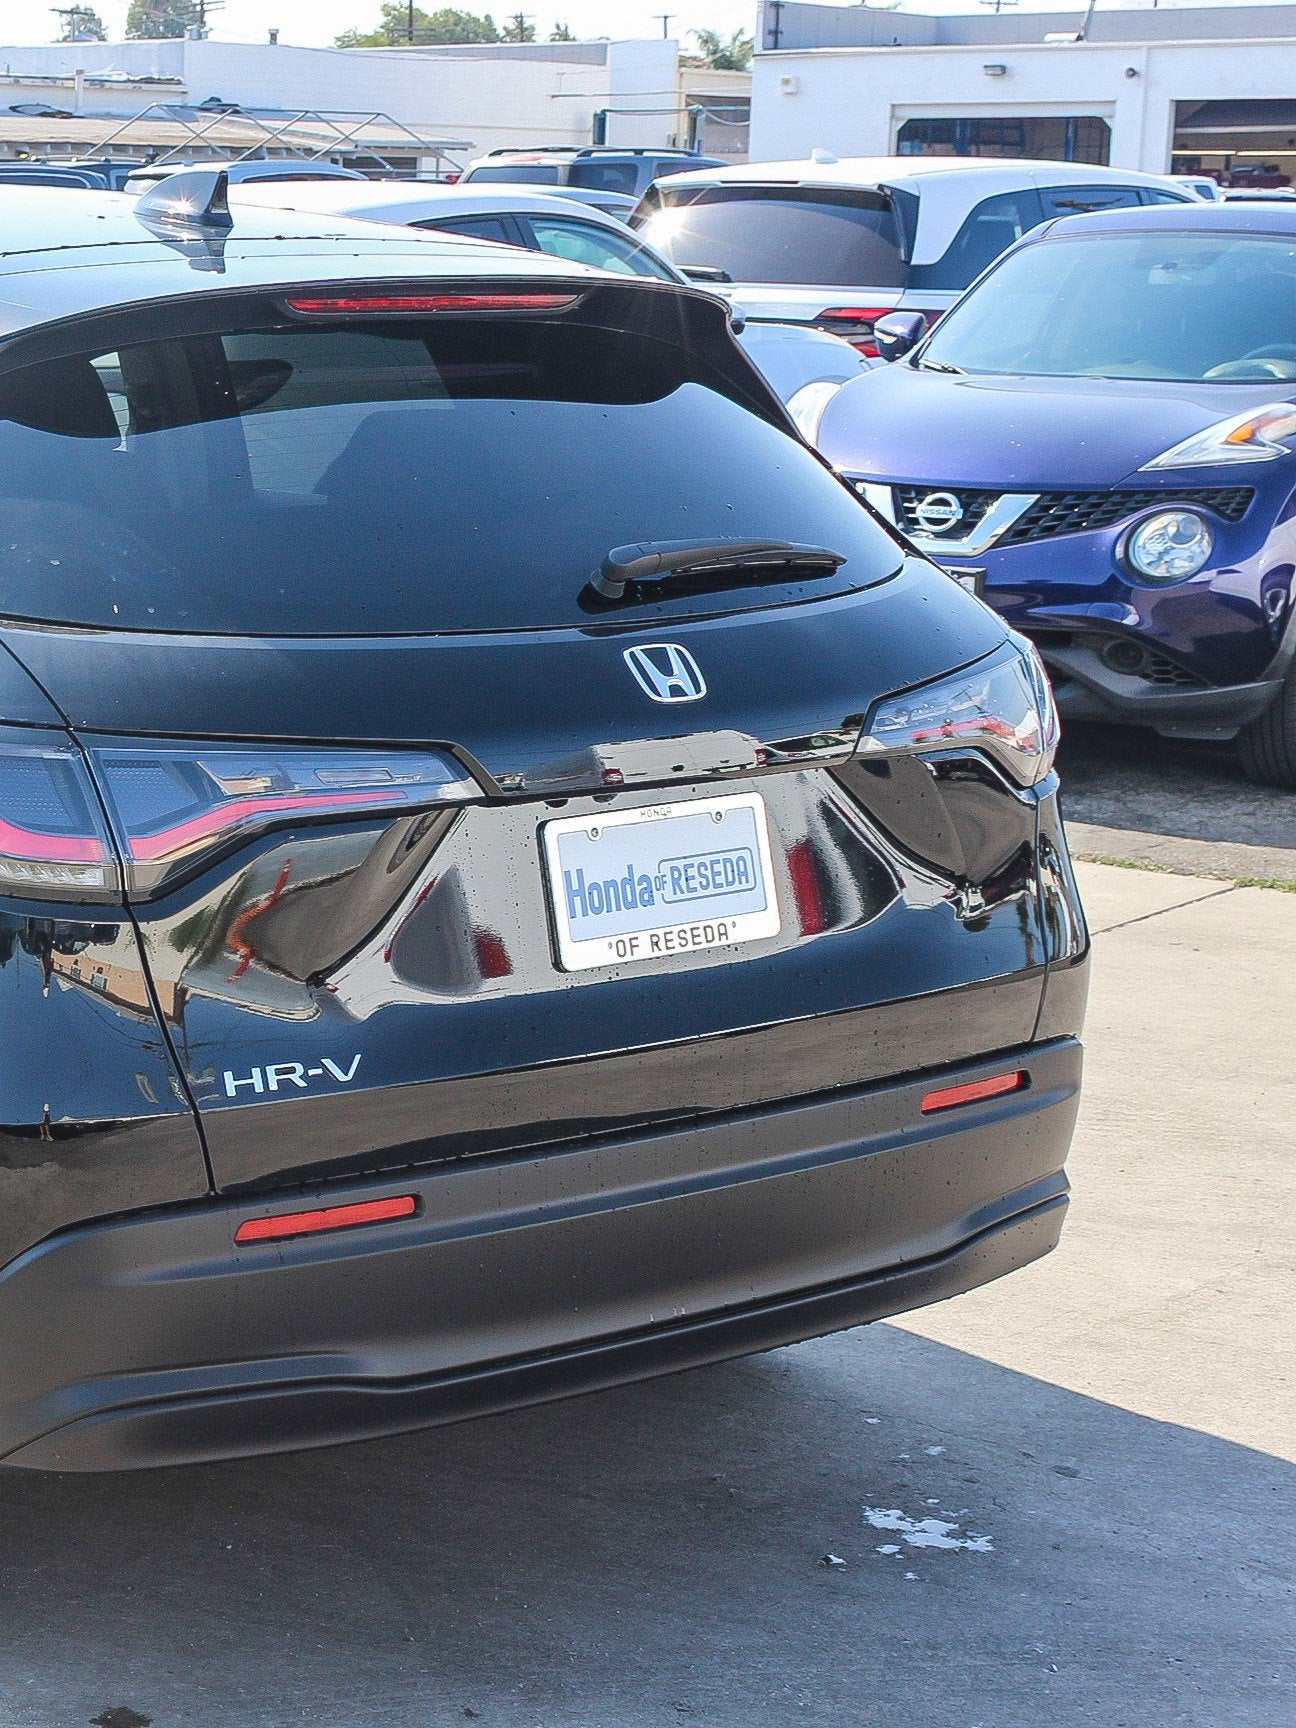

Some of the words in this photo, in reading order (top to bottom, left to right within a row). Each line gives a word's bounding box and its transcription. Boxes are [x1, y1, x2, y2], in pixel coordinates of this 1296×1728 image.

[920, 508, 957, 517] NISSAN
[639, 807, 673, 819] HONDA
[563, 864, 655, 920] Honda
[654, 873, 668, 892] OF
[669, 854, 750, 897] RESEDA
[615, 937, 640, 959] OF
[650, 922, 730, 954] RESEDA
[222, 1053, 362, 1098] HR-V
